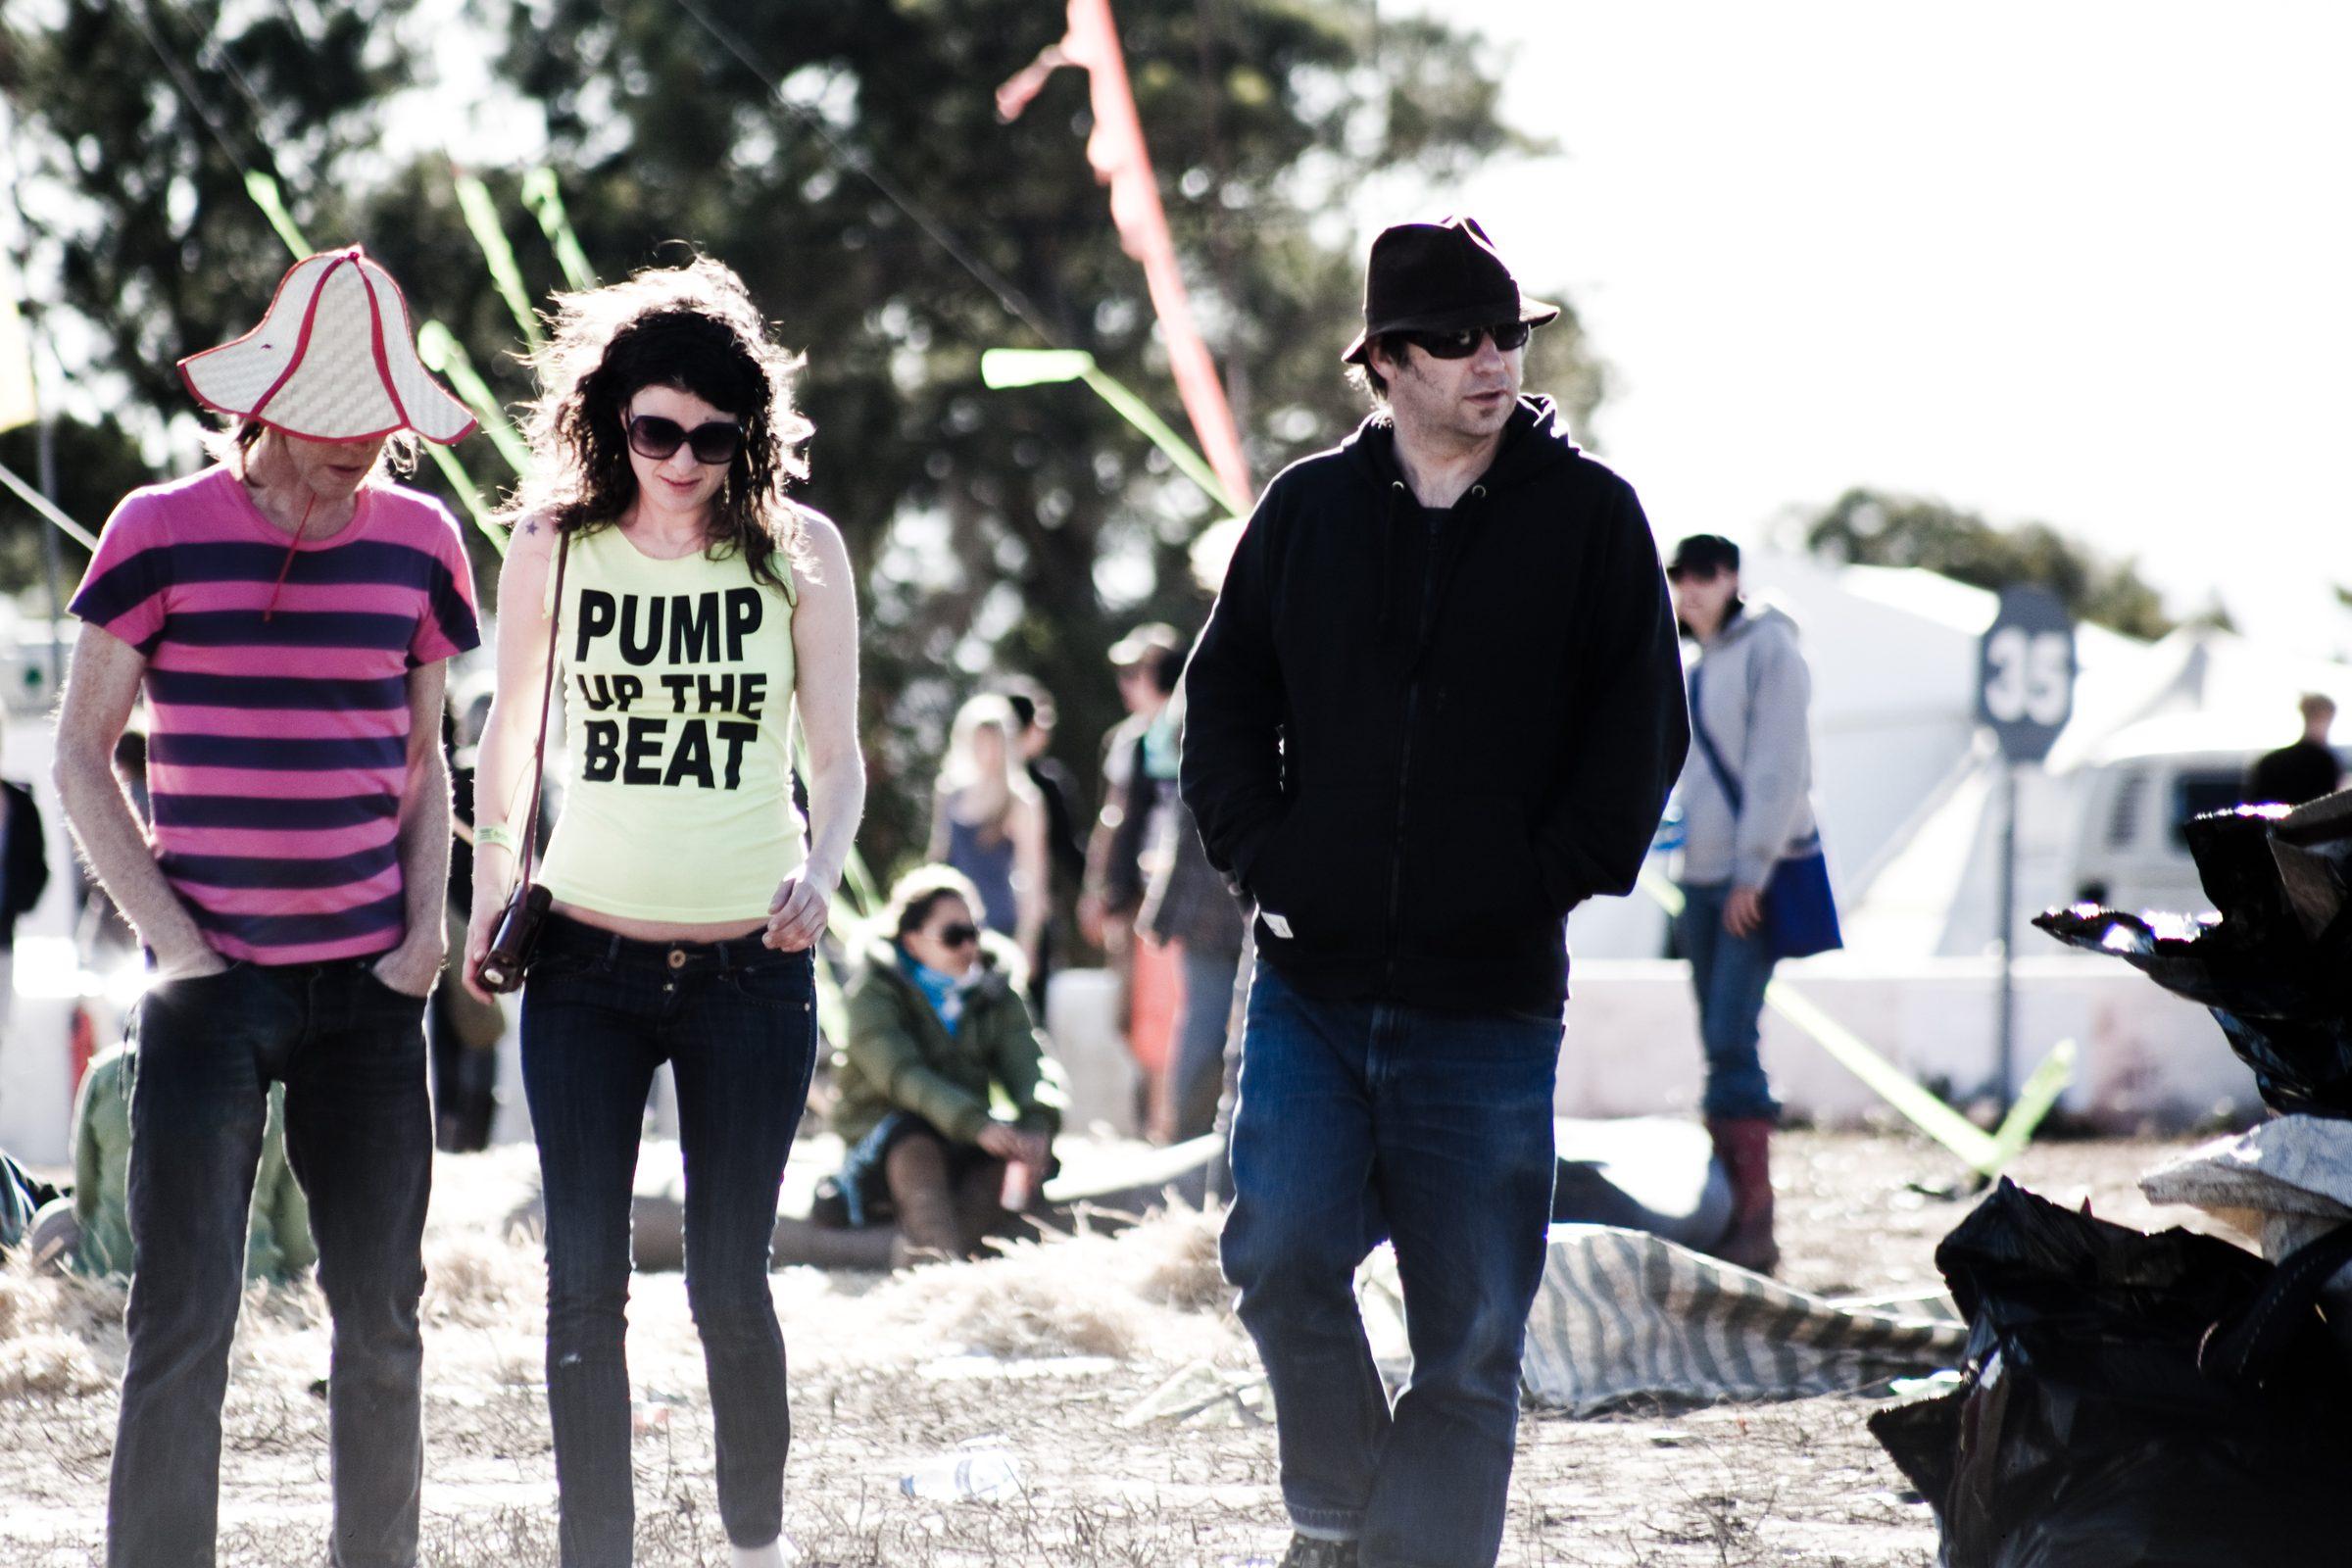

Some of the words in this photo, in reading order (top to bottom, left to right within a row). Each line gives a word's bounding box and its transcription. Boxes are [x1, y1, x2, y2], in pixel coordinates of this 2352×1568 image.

[575, 587, 762, 666] PUMP
[576, 673, 643, 711] UP
[661, 673, 766, 720] THE
[1985, 626, 2070, 725] 35
[582, 716, 759, 790] BEAT
